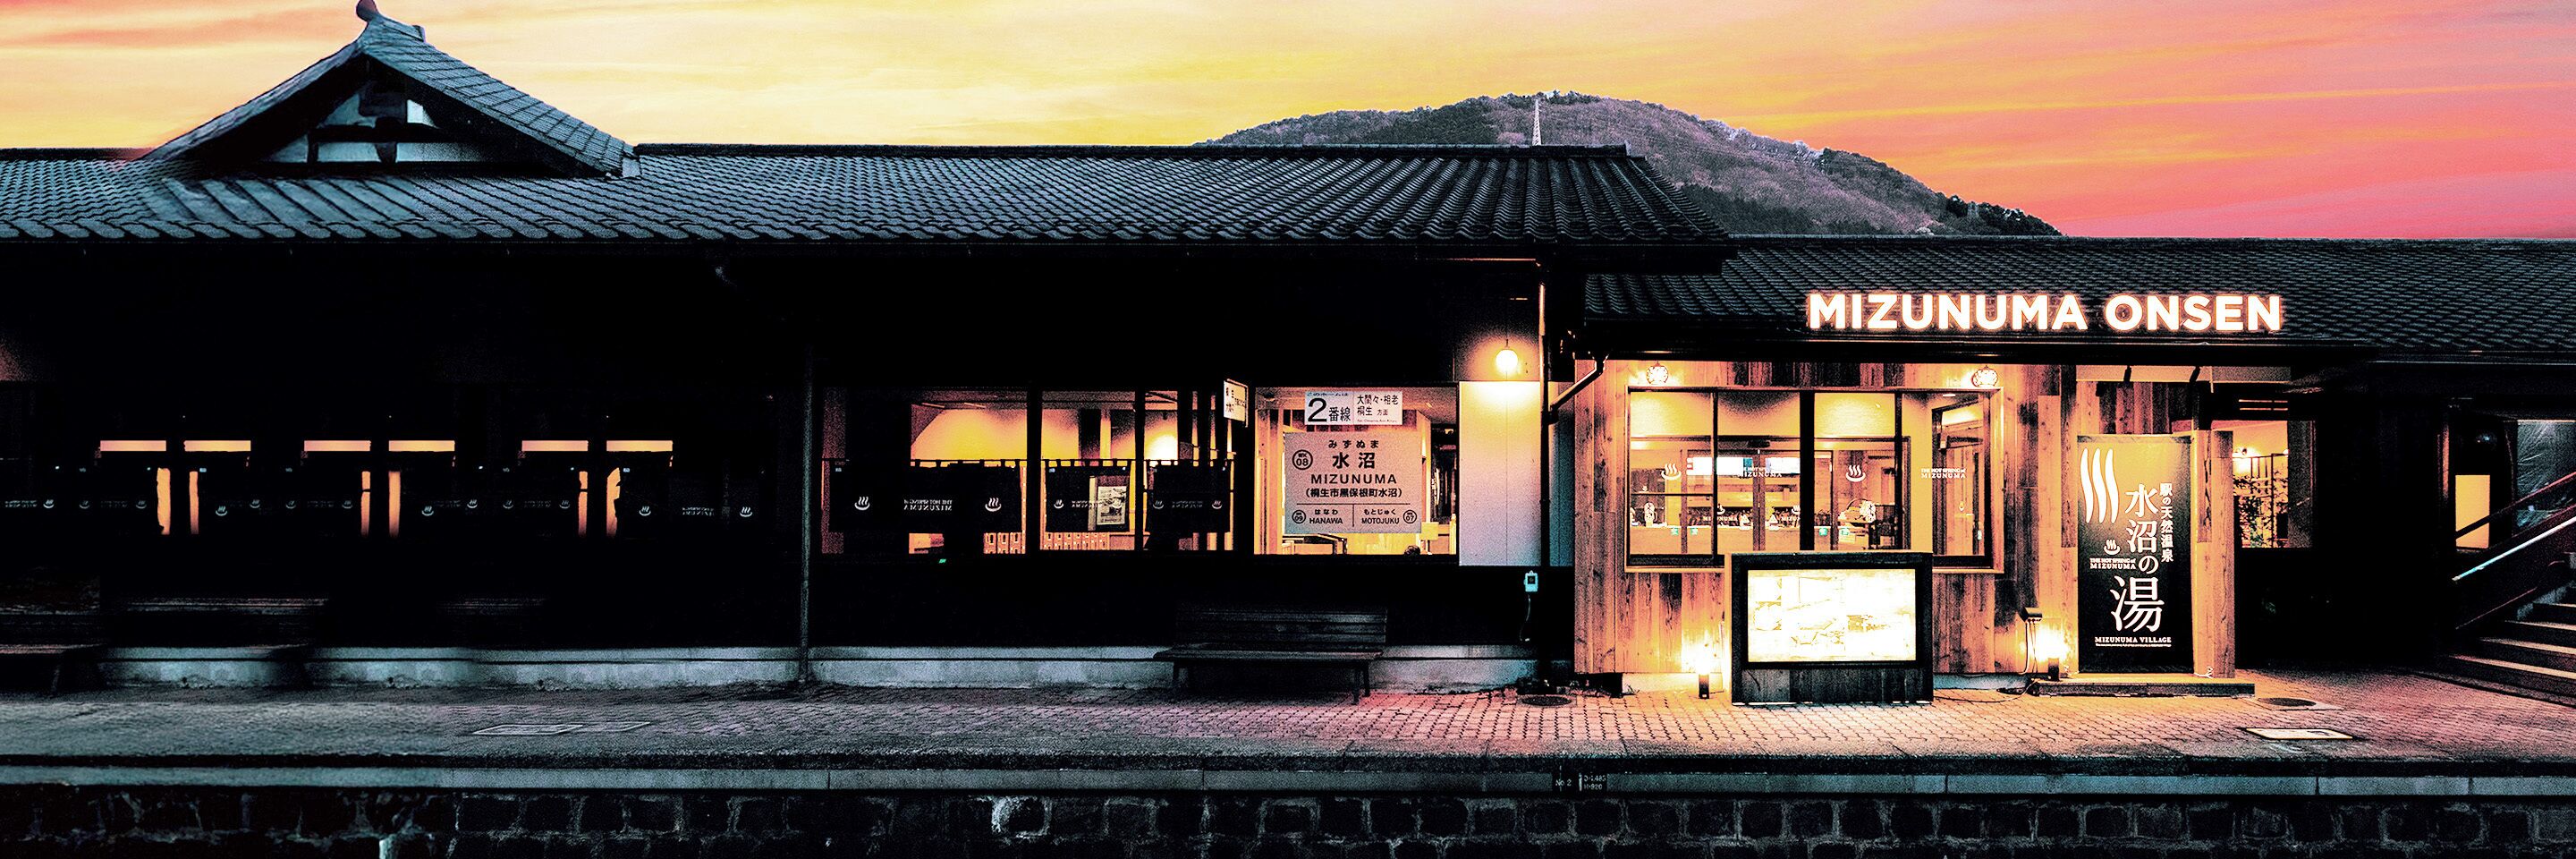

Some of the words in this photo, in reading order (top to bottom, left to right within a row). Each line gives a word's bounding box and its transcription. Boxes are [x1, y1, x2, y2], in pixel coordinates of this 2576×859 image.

[1809, 293, 2088, 330] MIZUNUMA
[2105, 294, 2282, 331] ONSEN
[1328, 439, 1378, 449] みずぬま
[1296, 458, 1309, 466] 08
[1332, 452, 1375, 469] 水沼
[1311, 473, 1397, 484] MIZUNUMA
[2159, 482, 2174, 563] 駅の天然温泉
[2109, 483, 2165, 633] 水沼の湯
